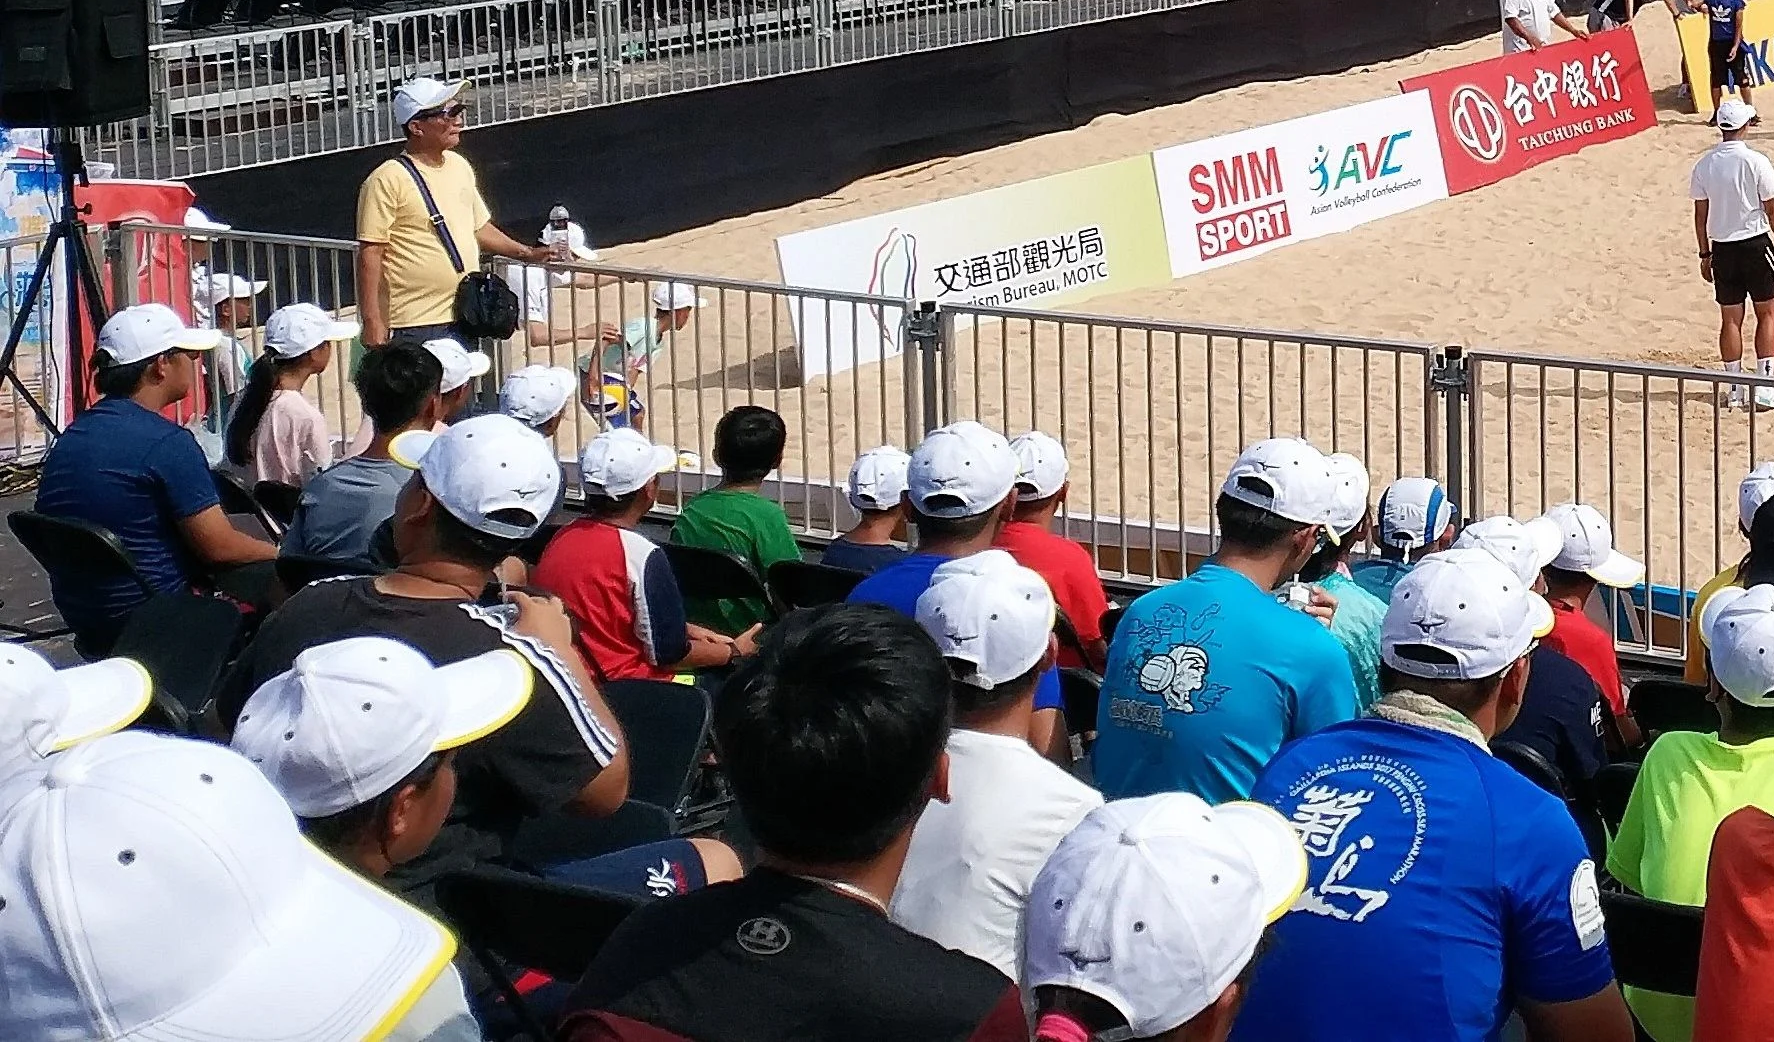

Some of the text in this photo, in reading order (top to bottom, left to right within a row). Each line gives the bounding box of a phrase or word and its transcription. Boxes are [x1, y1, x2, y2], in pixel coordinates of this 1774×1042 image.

[1504, 51, 1621, 127] 台中銀行
[1518, 108, 1636, 151] TAICHUNG BANK
[1188, 147, 1283, 214] SMM
[1333, 130, 1412, 190] AVC
[1310, 177, 1422, 216] Asian Volleyball Confederation
[1199, 204, 1288, 256] SPORT
[934, 227, 1104, 298] 交通部觀光局
[1002, 278, 1060, 304] Bureau,
[1063, 262, 1107, 288] MOTC
